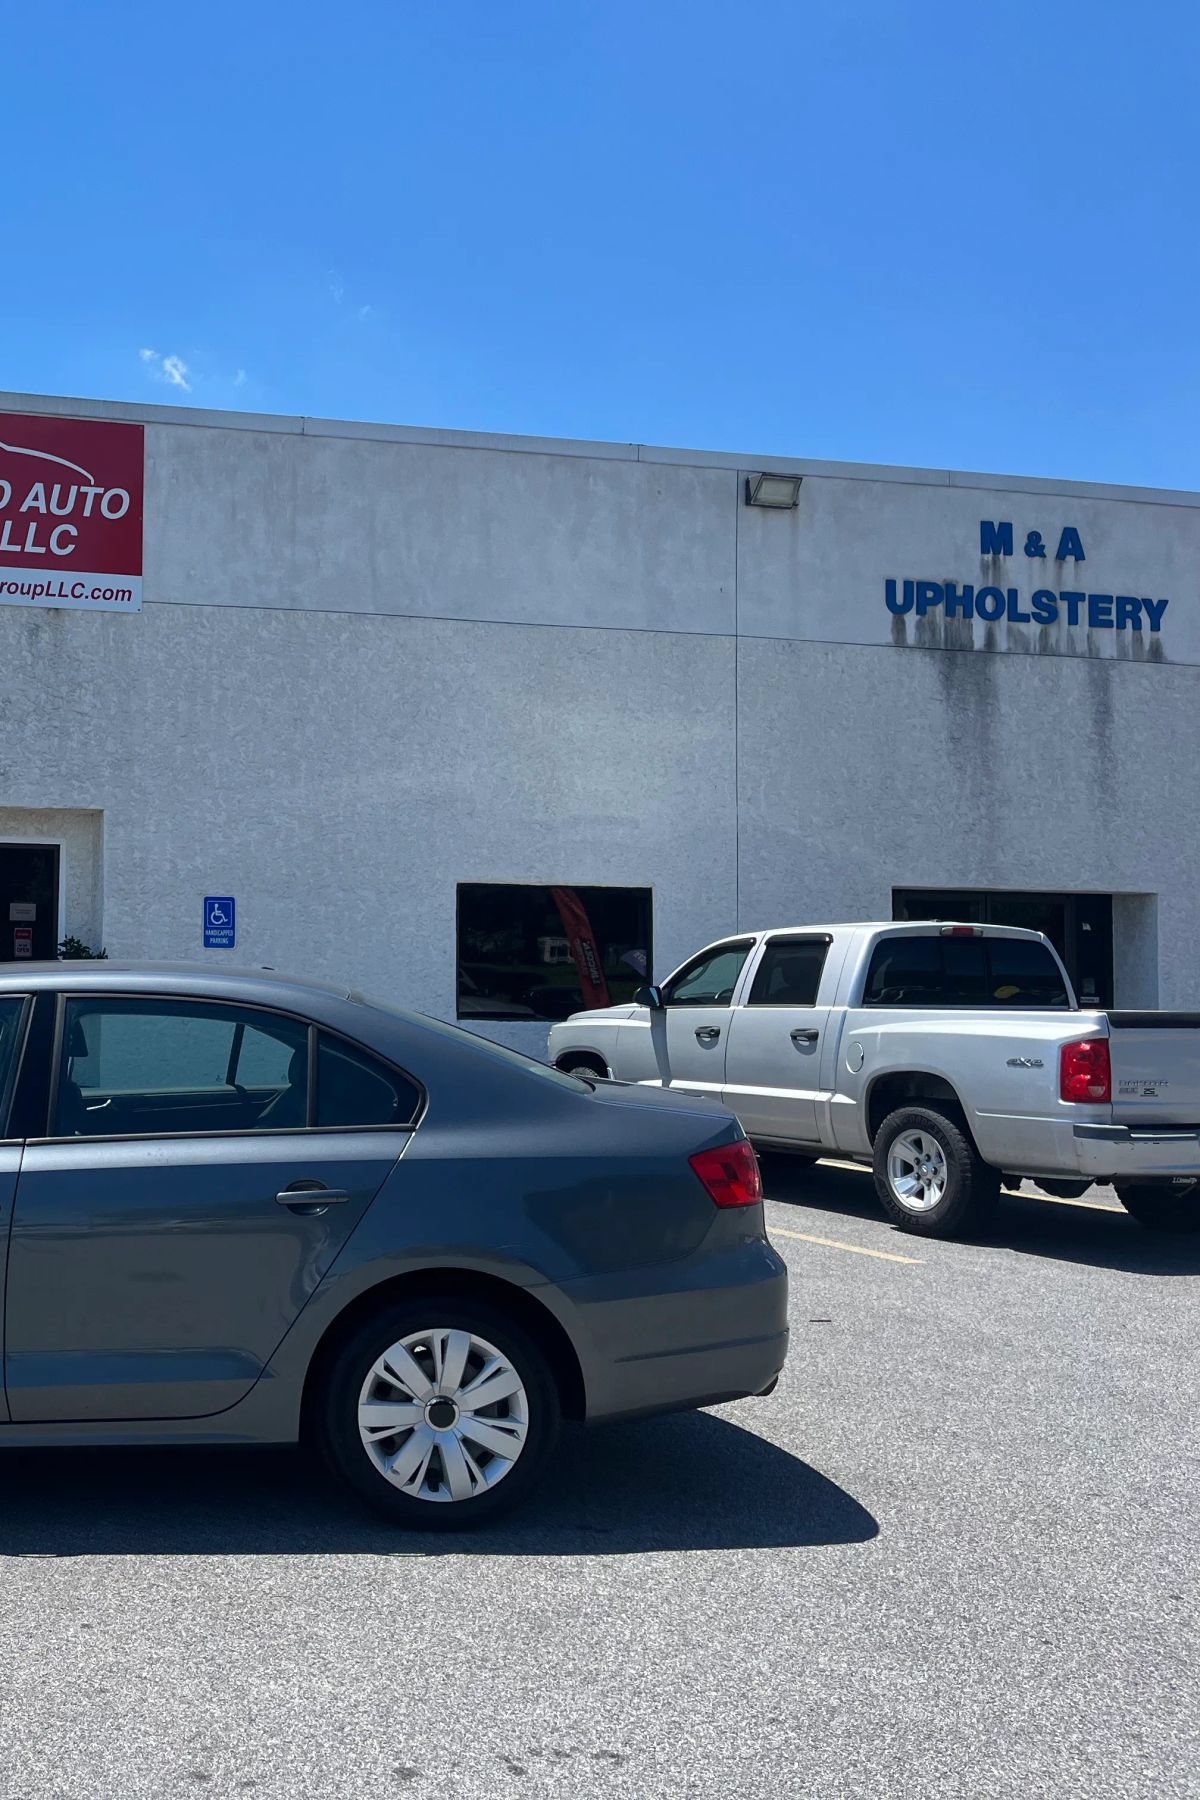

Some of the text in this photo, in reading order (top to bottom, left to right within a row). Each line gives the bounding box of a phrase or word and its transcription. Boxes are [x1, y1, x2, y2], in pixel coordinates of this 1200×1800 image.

[19, 482, 131, 520] AUTO
[0, 520, 79, 556] LLC
[980, 520, 1086, 561] M & A
[885, 579, 1169, 632] UPHOLSTERY
